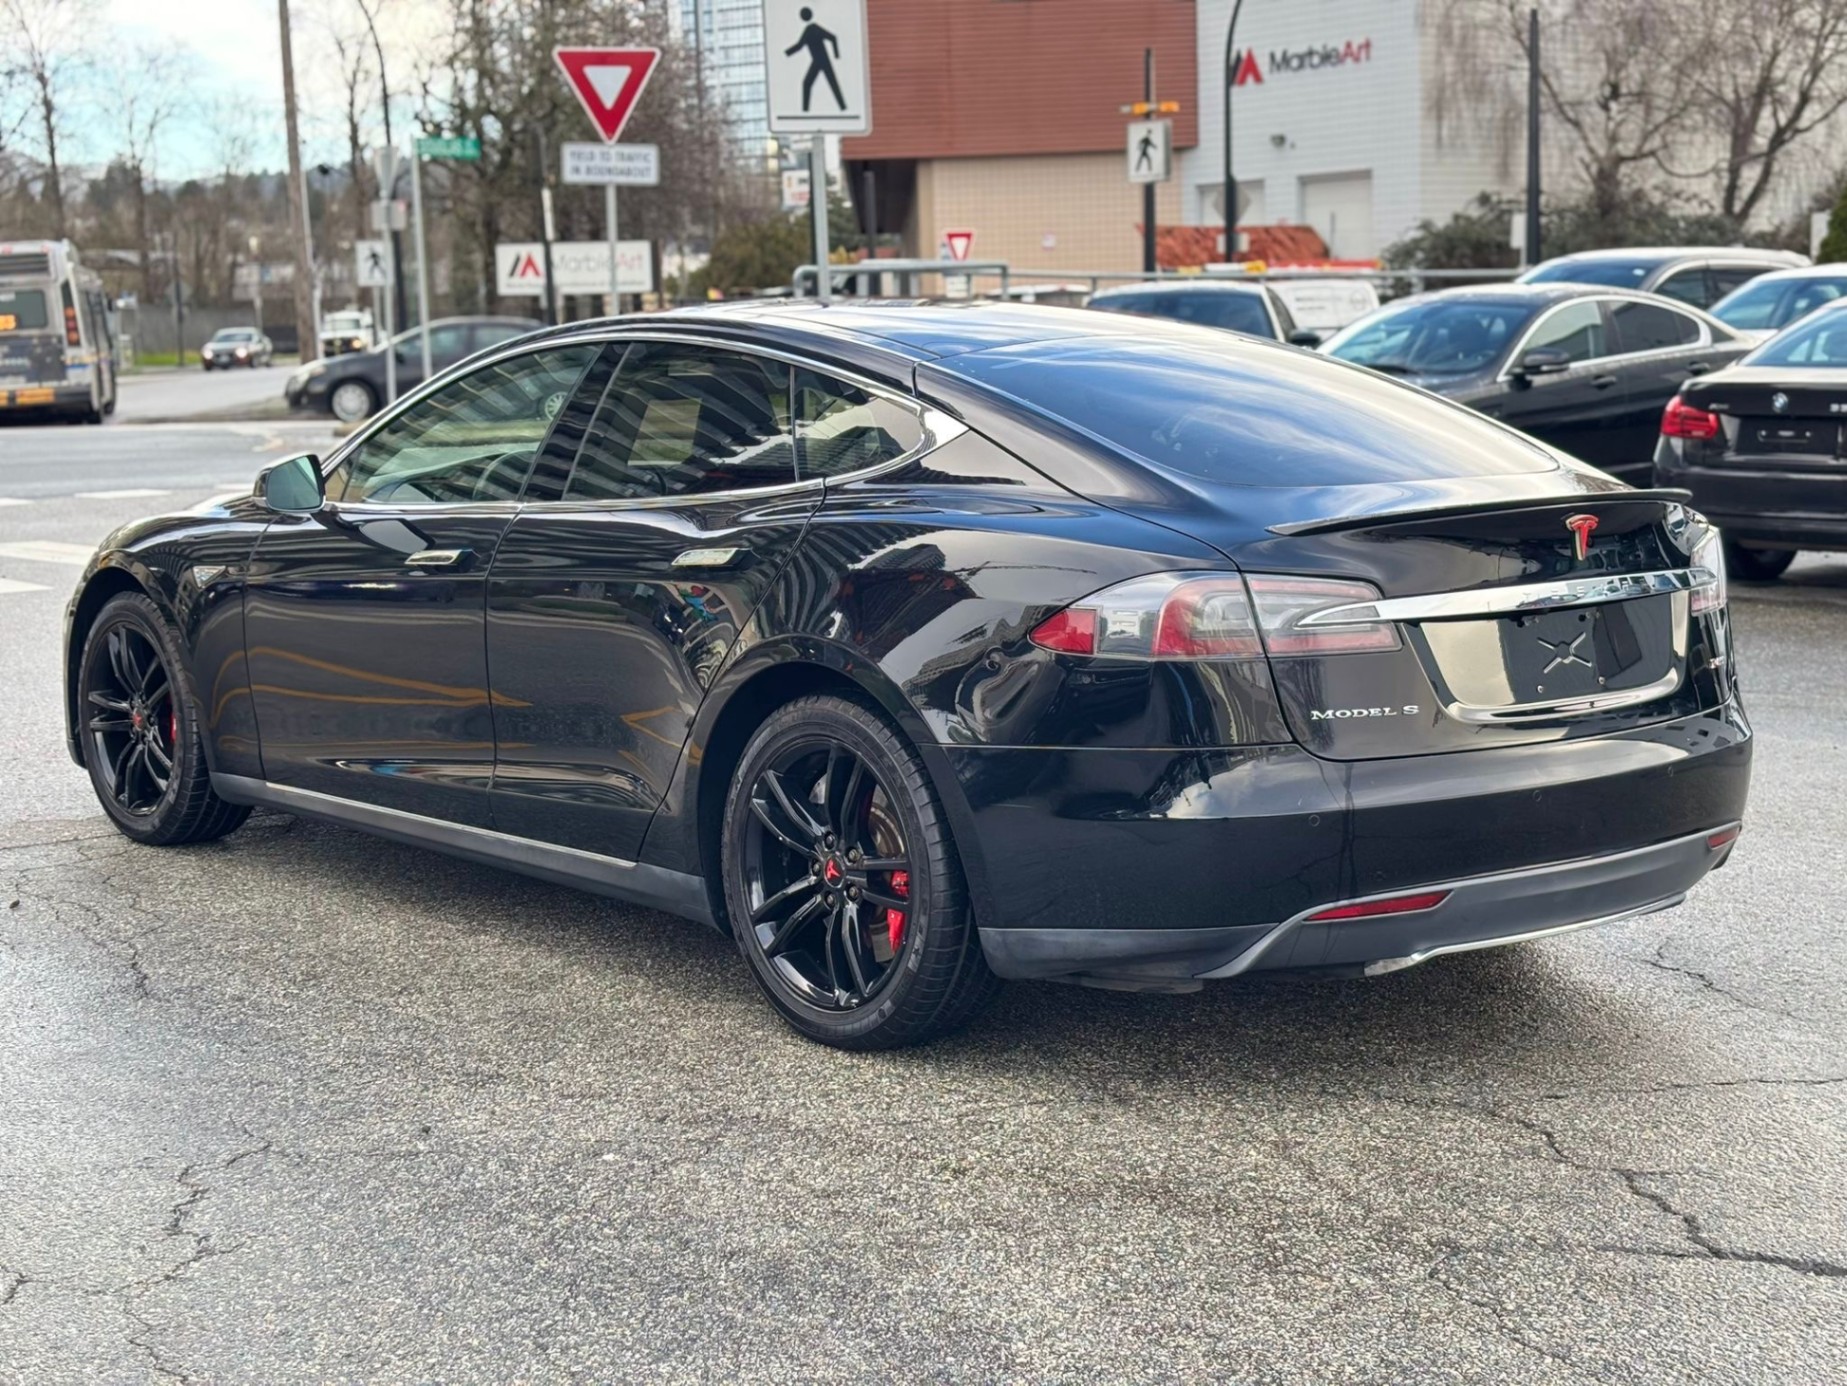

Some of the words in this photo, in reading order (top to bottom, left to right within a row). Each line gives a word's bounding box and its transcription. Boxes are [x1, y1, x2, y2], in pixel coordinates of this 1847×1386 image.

[1269, 37, 1372, 74] MarbleArt
[1310, 707, 1397, 720] MODEL
[1402, 705, 1419, 715] S
